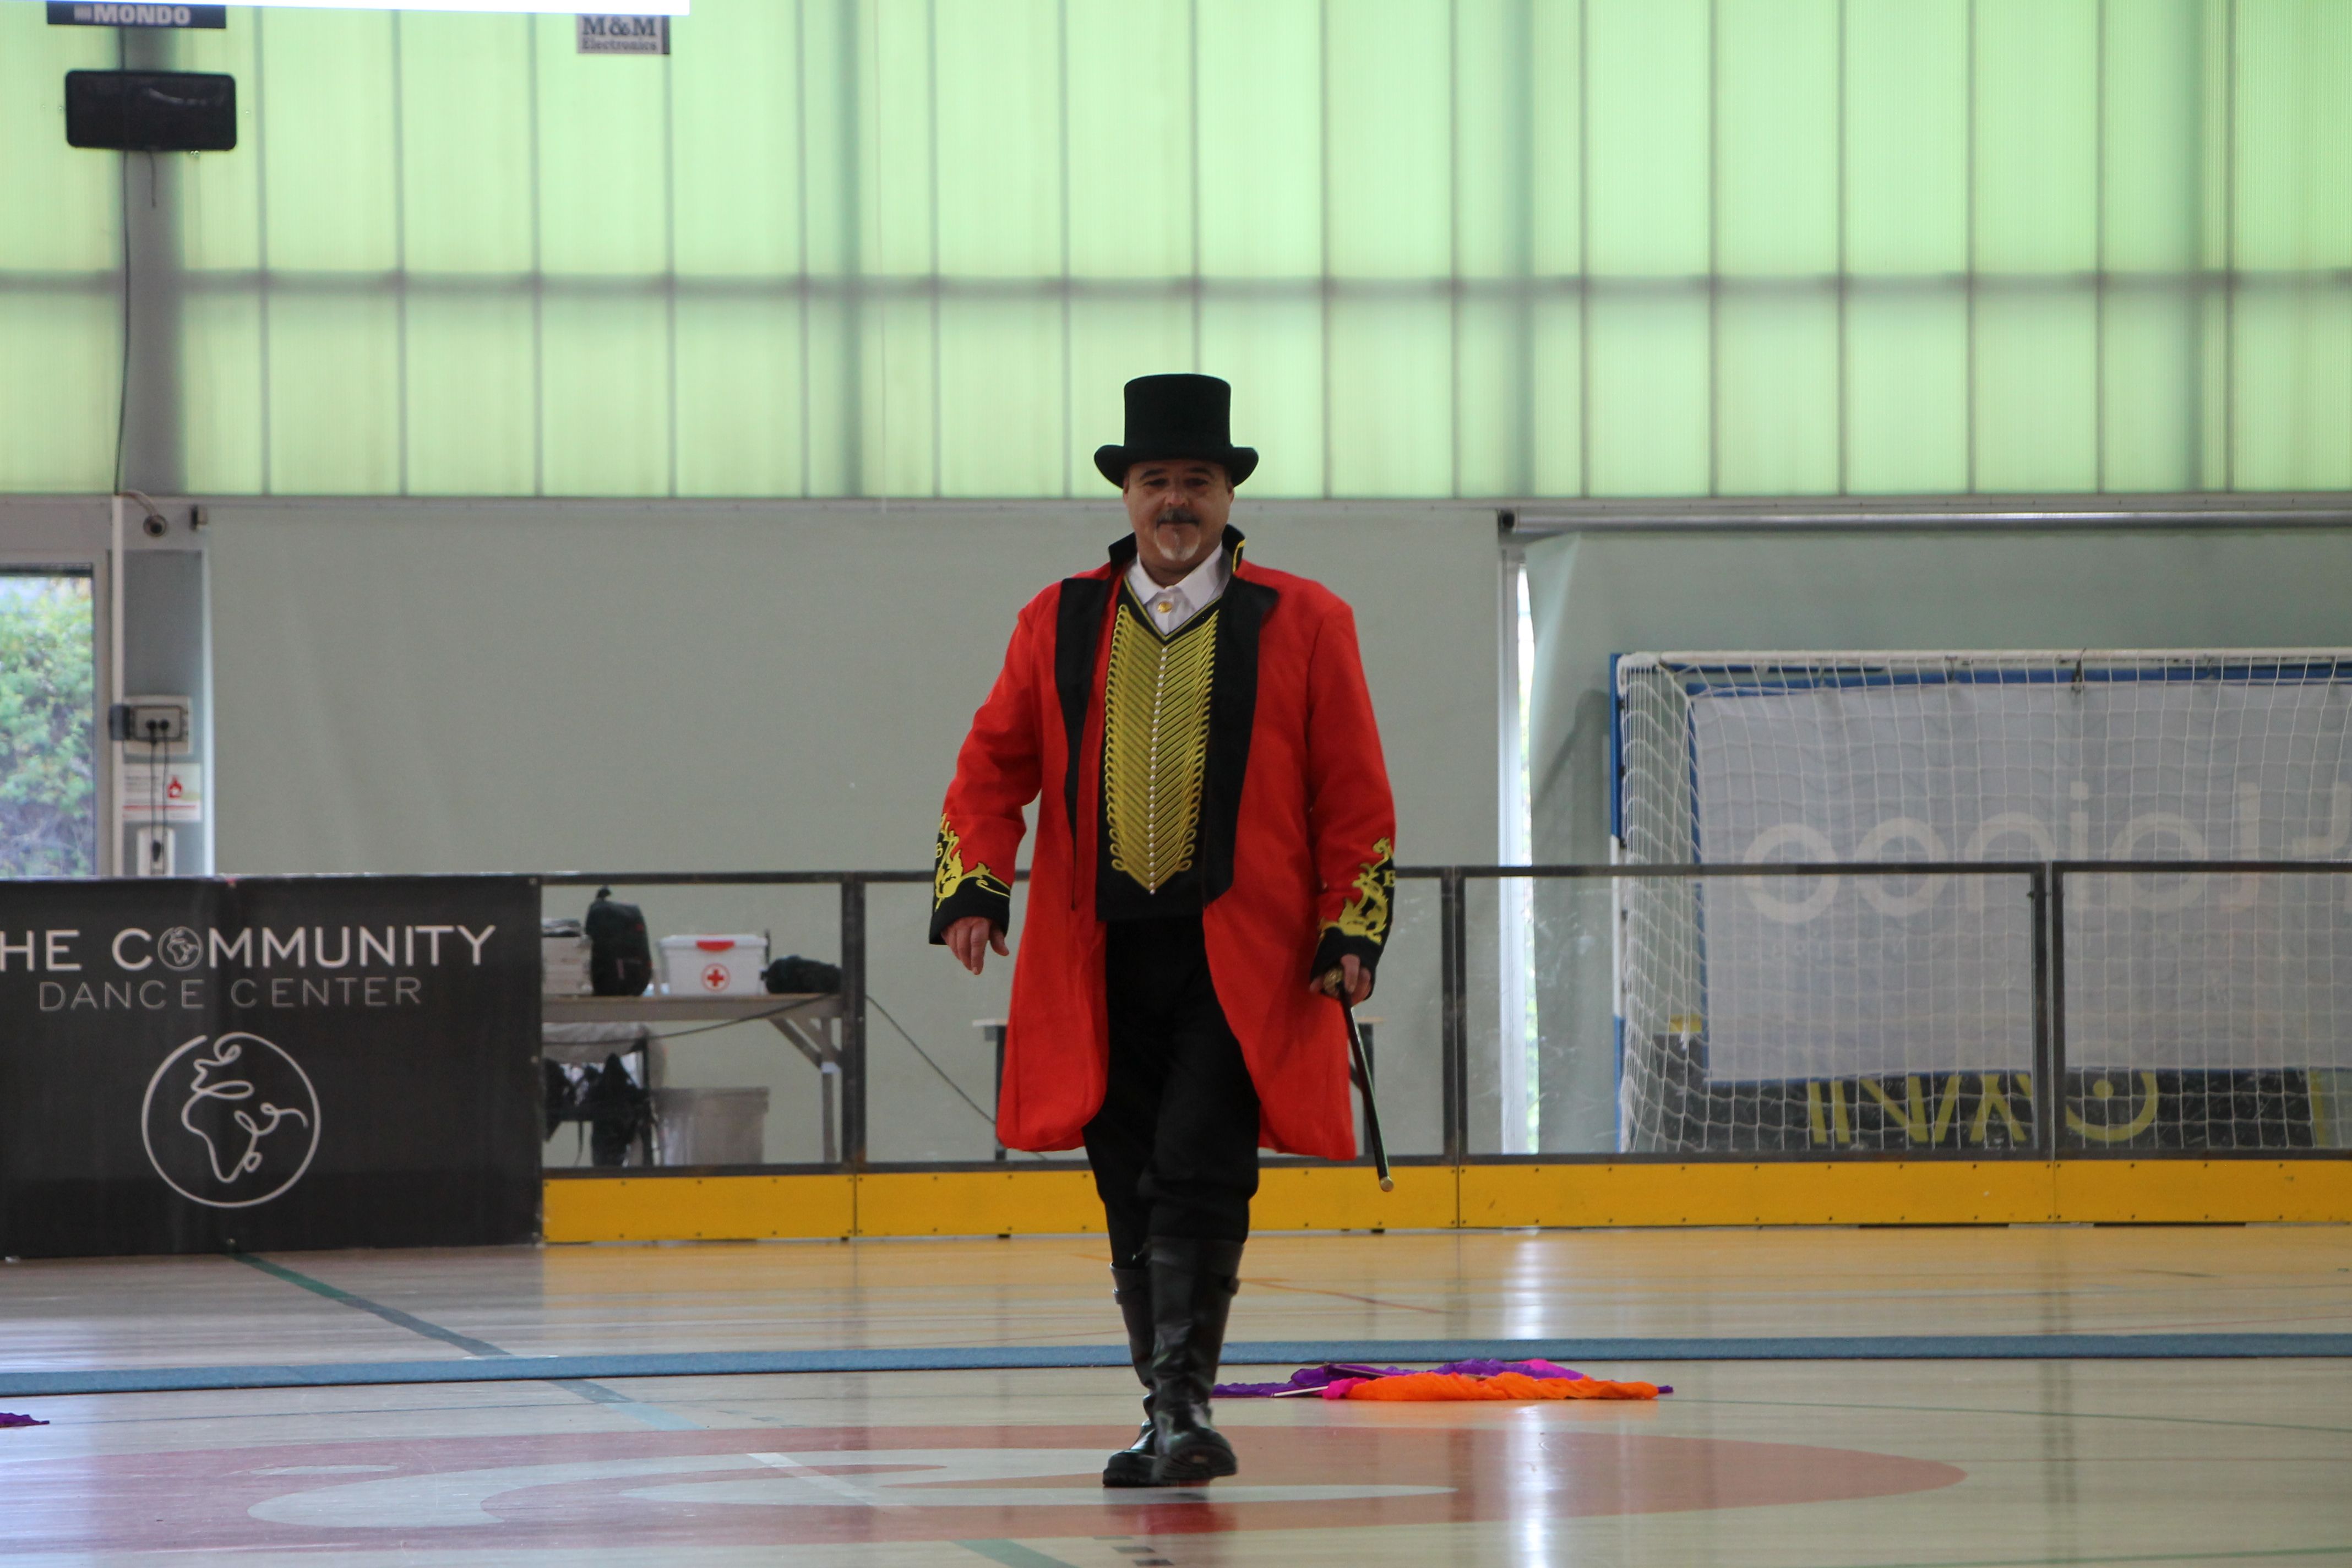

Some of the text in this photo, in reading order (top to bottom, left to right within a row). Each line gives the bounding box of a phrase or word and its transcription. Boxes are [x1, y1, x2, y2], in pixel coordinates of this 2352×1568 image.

[94, 4, 192, 25] MONDO
[112, 925, 496, 971] COMMUNITY
[40, 977, 422, 1011] DANCE CENTER
